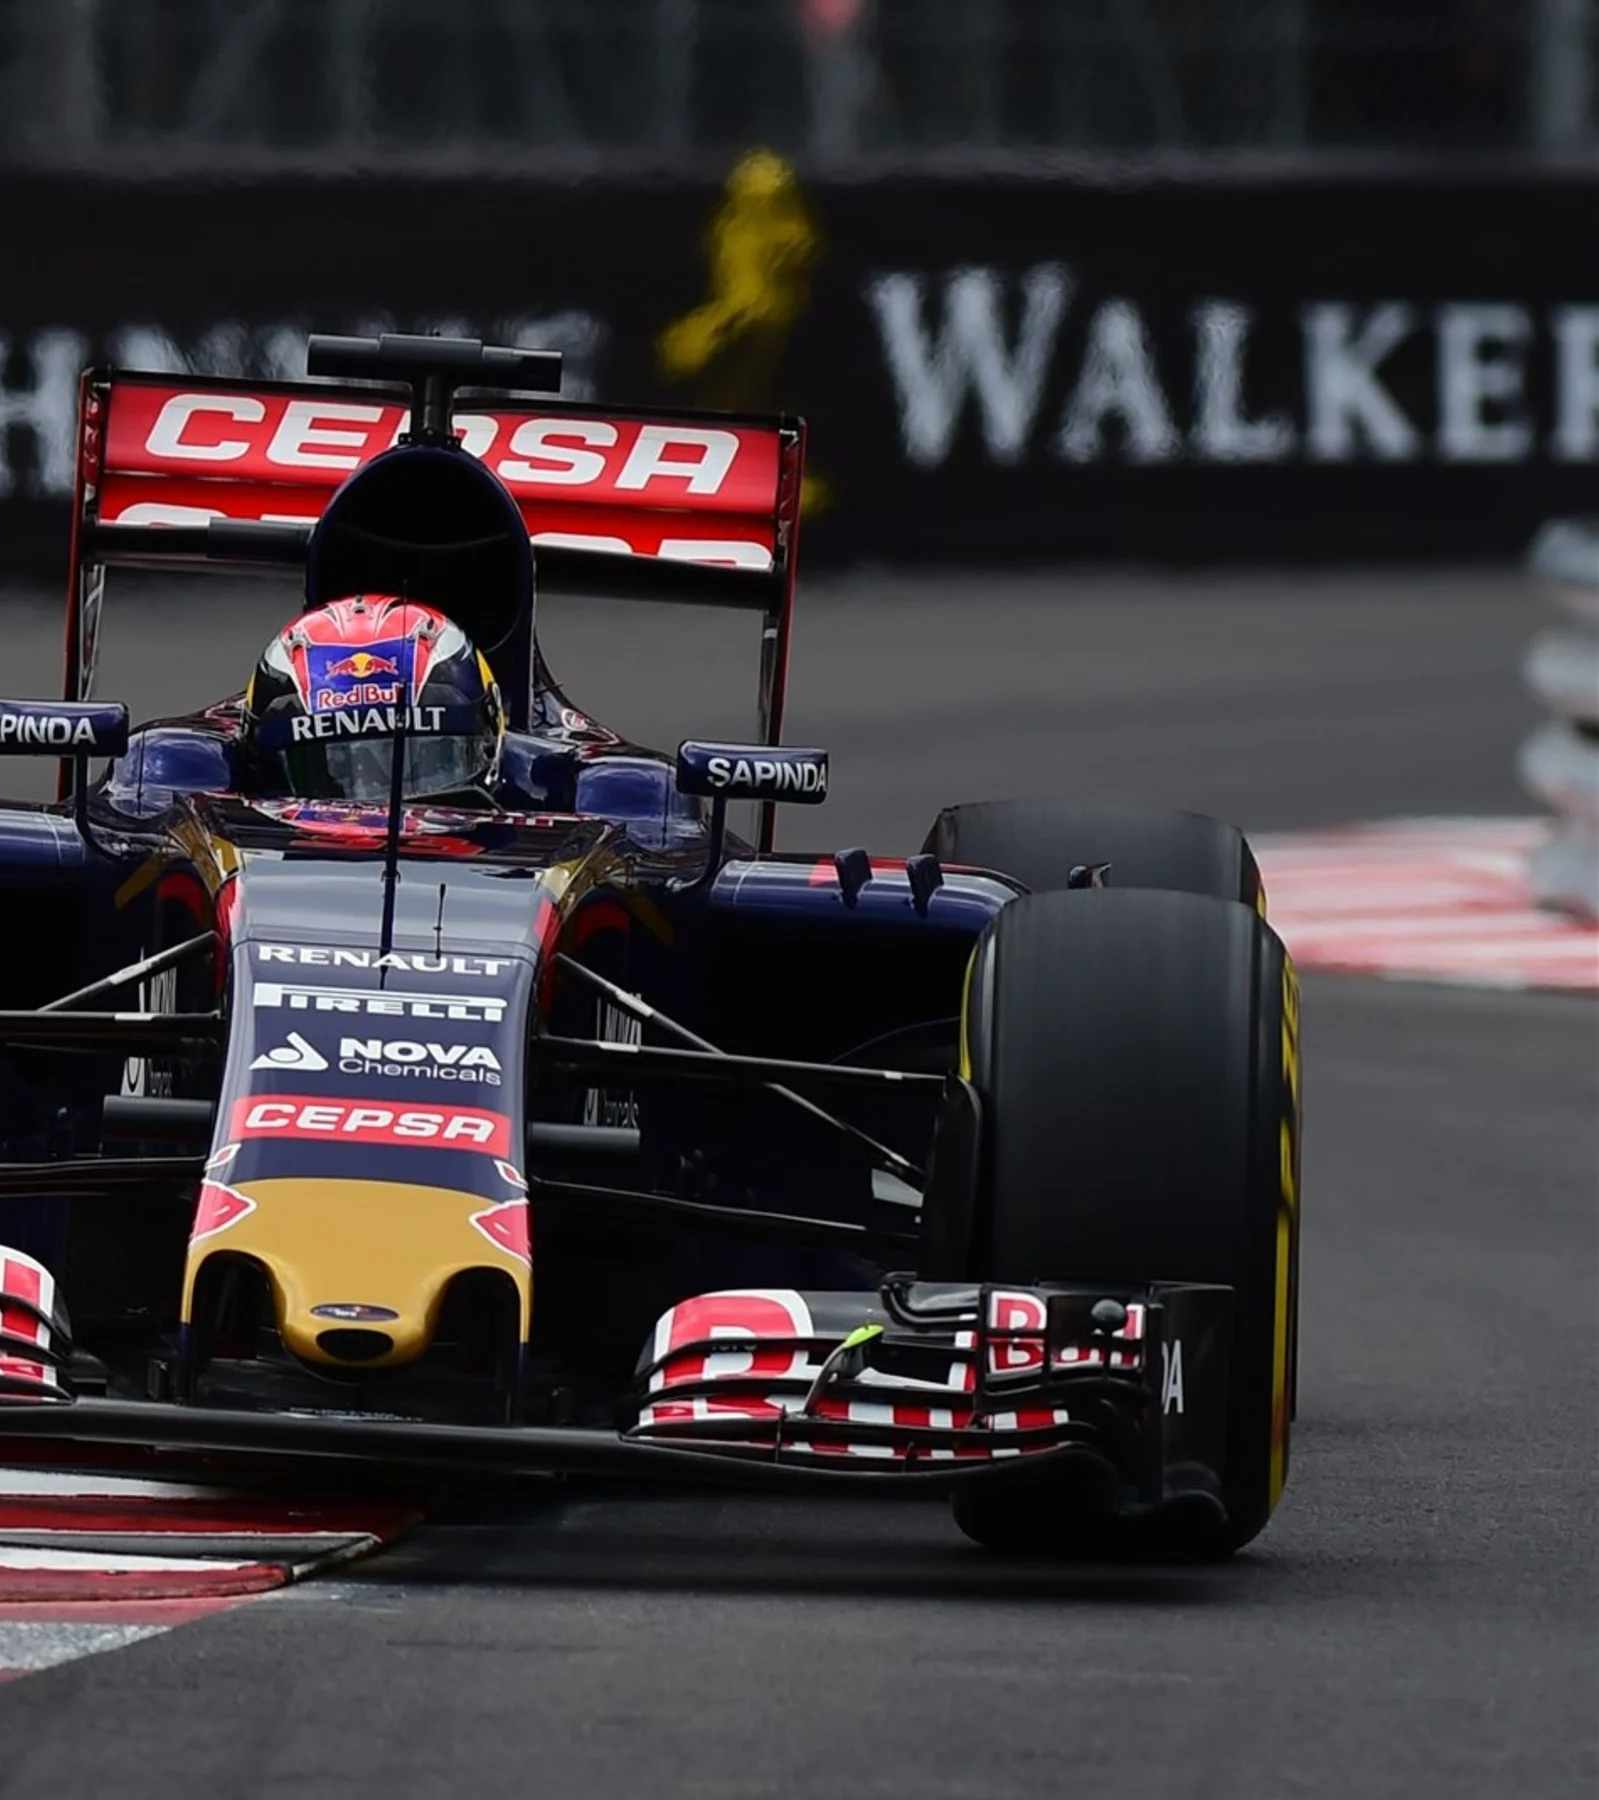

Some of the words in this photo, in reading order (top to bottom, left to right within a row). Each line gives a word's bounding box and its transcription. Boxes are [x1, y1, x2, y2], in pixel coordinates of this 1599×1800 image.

[317, 685, 362, 710] Red
[706, 757, 827, 792] SAPINDA
[258, 944, 511, 976] RENAULT
[253, 982, 508, 1022] PIRELLI
[339, 1037, 502, 1071] NOVA
[338, 1057, 501, 1086] Chemicals
[245, 1103, 496, 1144] CEPSA
